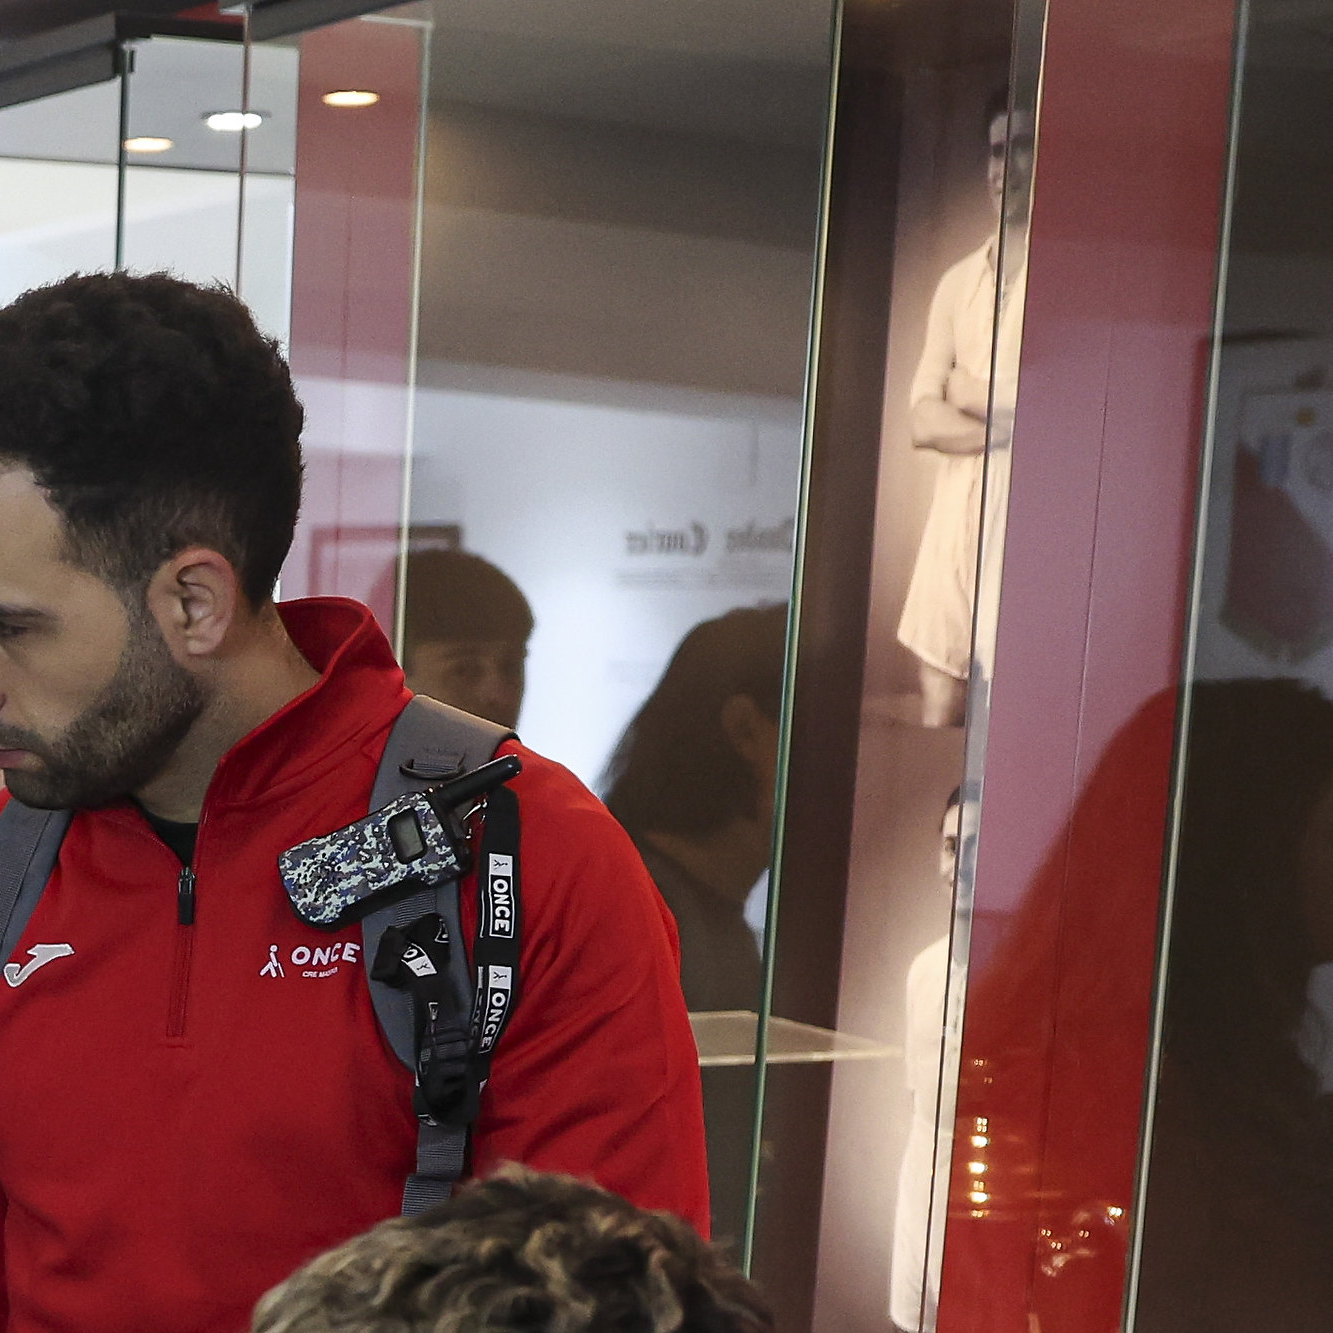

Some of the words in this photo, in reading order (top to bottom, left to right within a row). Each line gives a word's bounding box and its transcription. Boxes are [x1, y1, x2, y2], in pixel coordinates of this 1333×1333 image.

[493, 878, 510, 932] ONCE
[291, 942, 361, 966] ONCE
[481, 992, 506, 1048] ONCE
